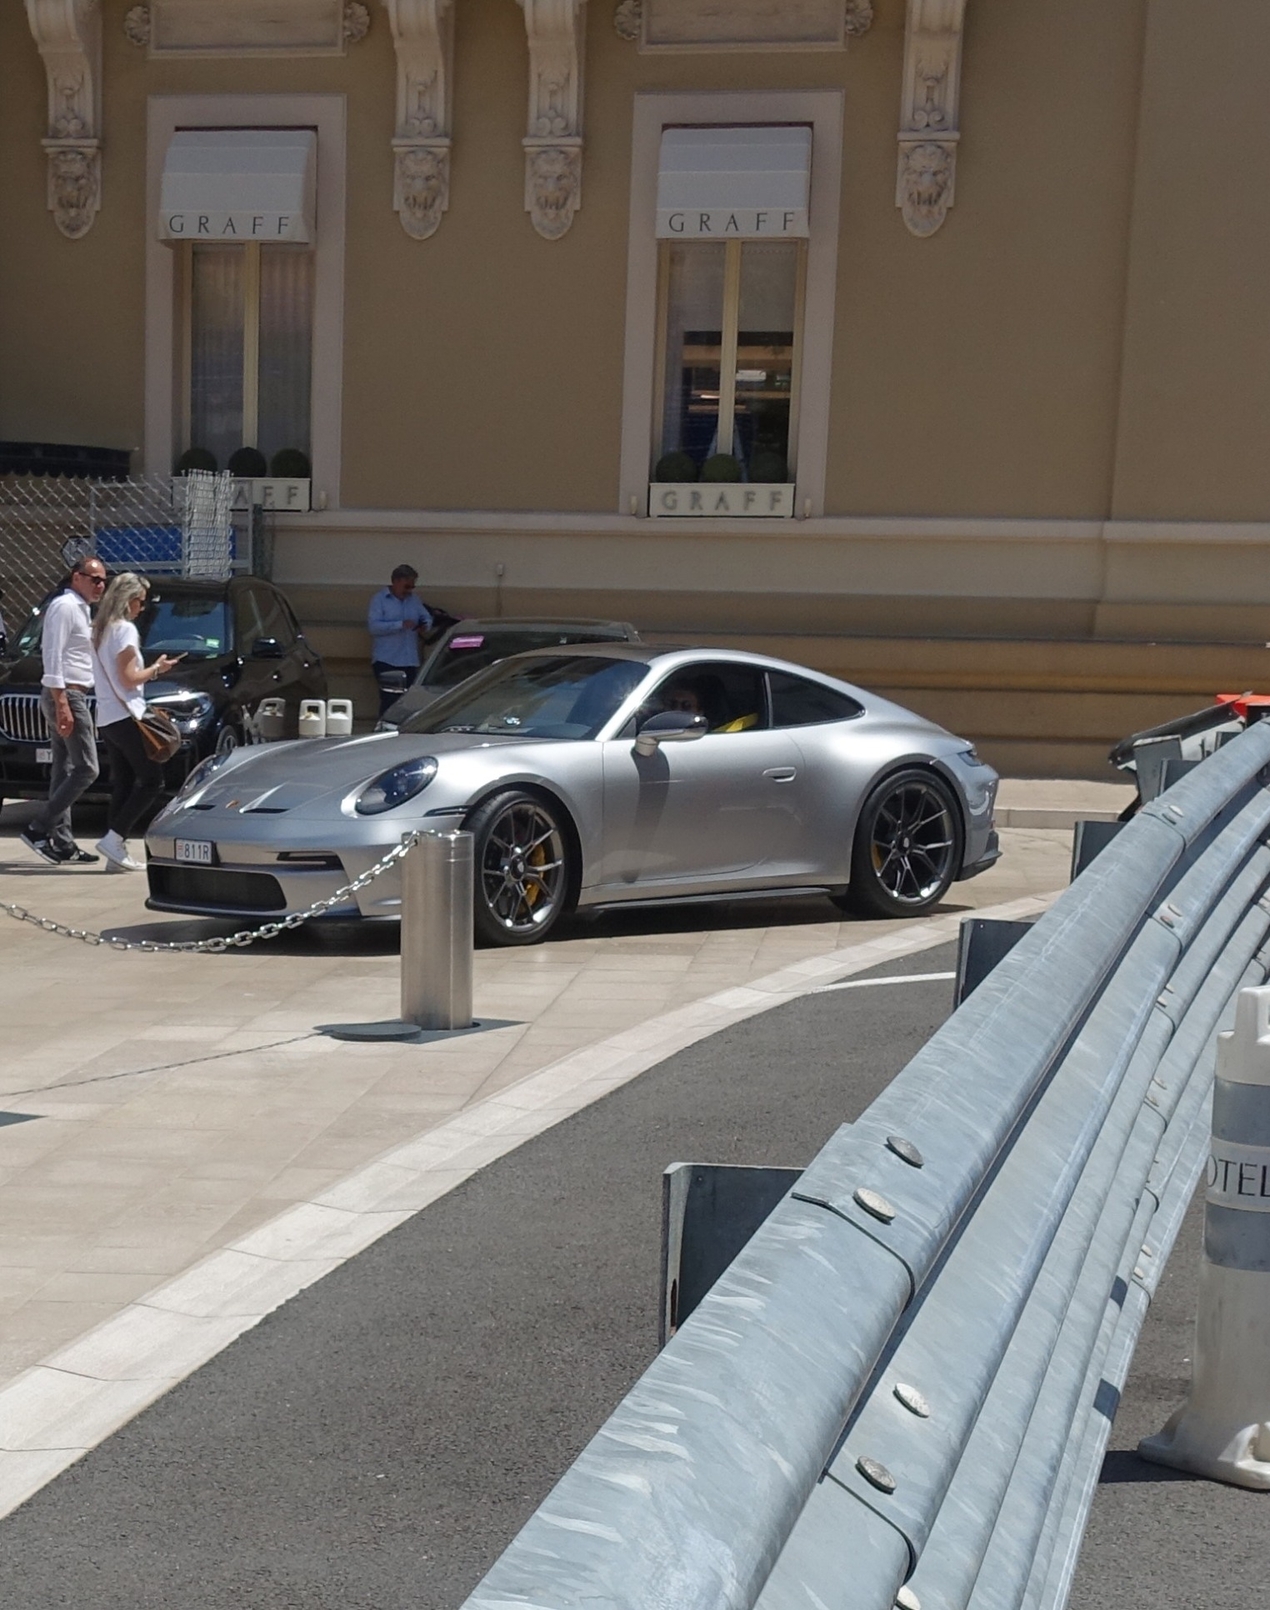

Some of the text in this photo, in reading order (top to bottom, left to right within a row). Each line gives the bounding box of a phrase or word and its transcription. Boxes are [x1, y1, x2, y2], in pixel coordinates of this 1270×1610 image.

[169, 214, 290, 235] GRAFF
[668, 211, 795, 232] GRAFF
[661, 490, 784, 511] GRAFF
